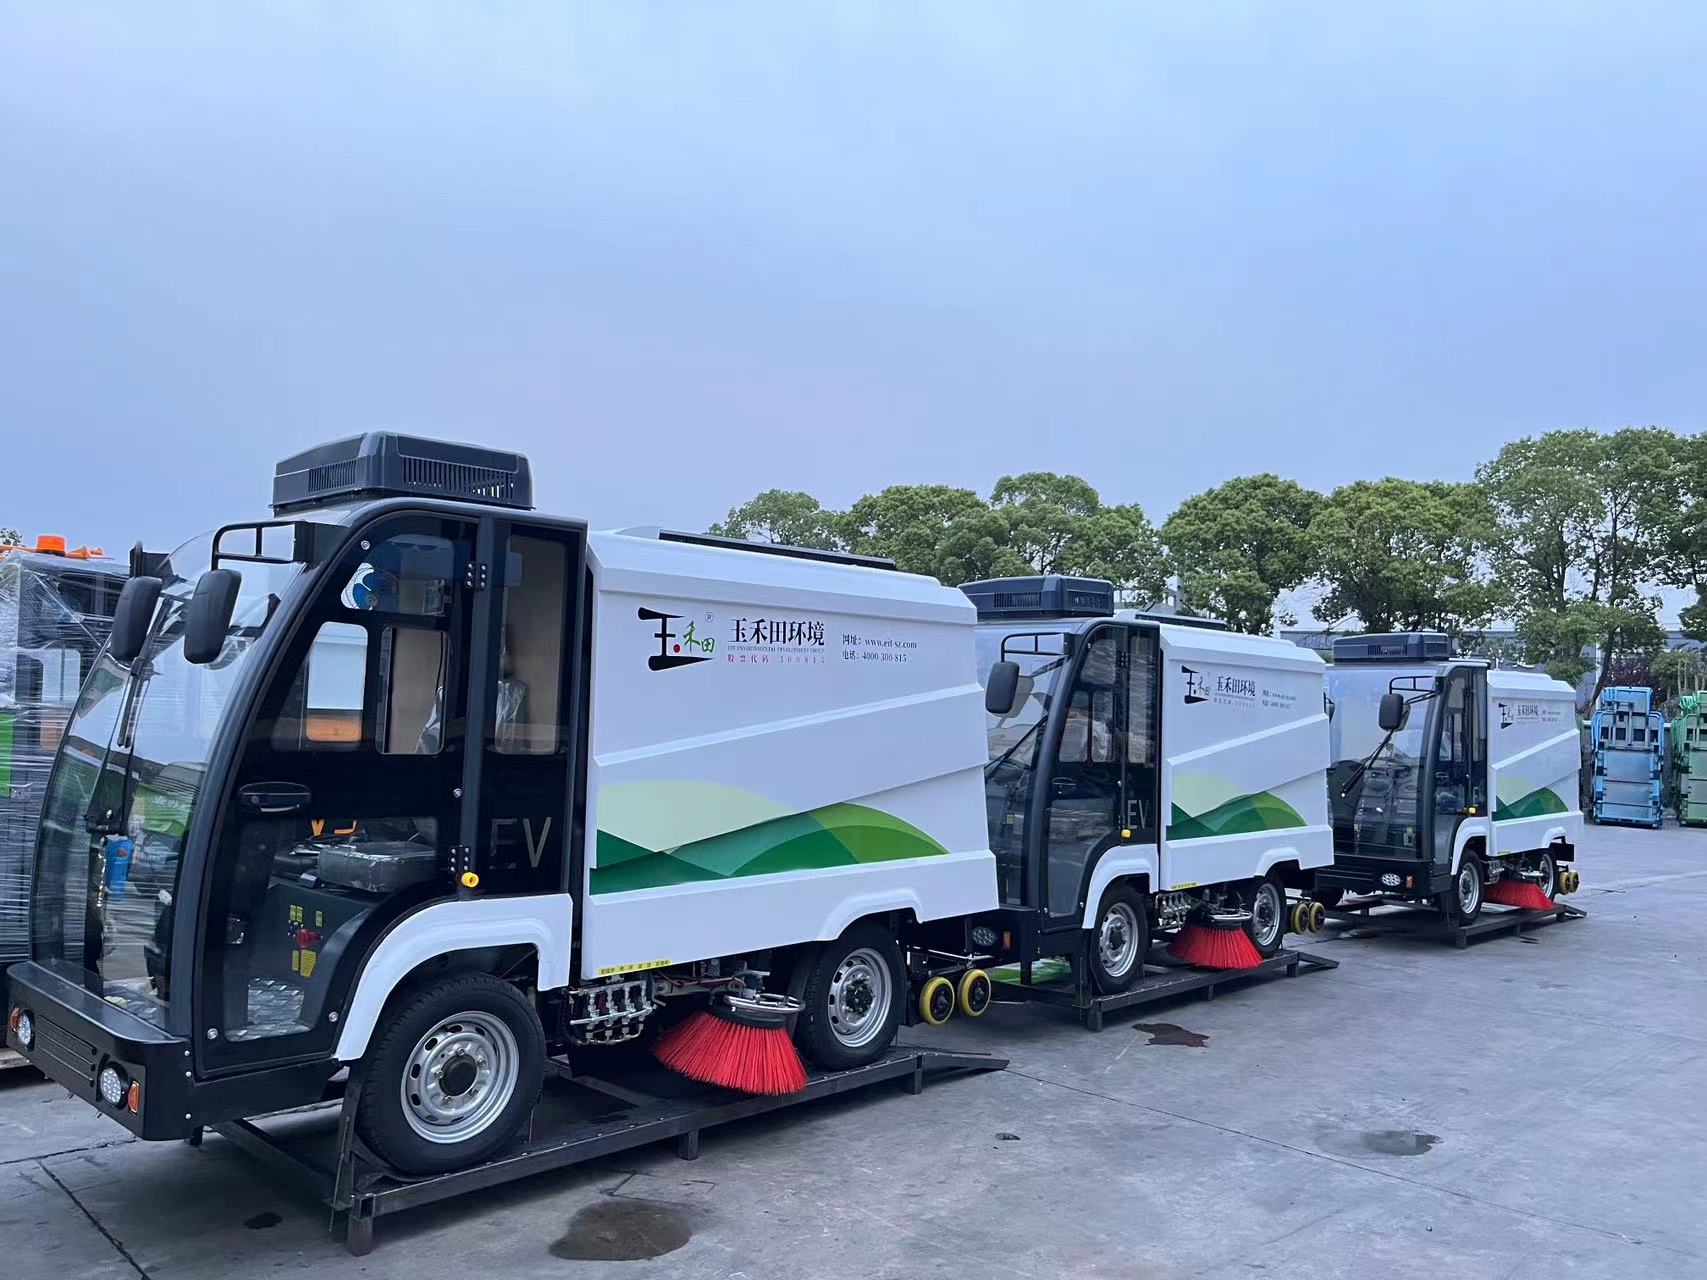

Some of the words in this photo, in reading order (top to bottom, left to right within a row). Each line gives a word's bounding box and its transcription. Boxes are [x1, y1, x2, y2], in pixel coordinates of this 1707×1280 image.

[727, 618, 825, 646] 玉禾田环境
[1127, 799, 1150, 829] EV
[488, 816, 552, 869] EV
